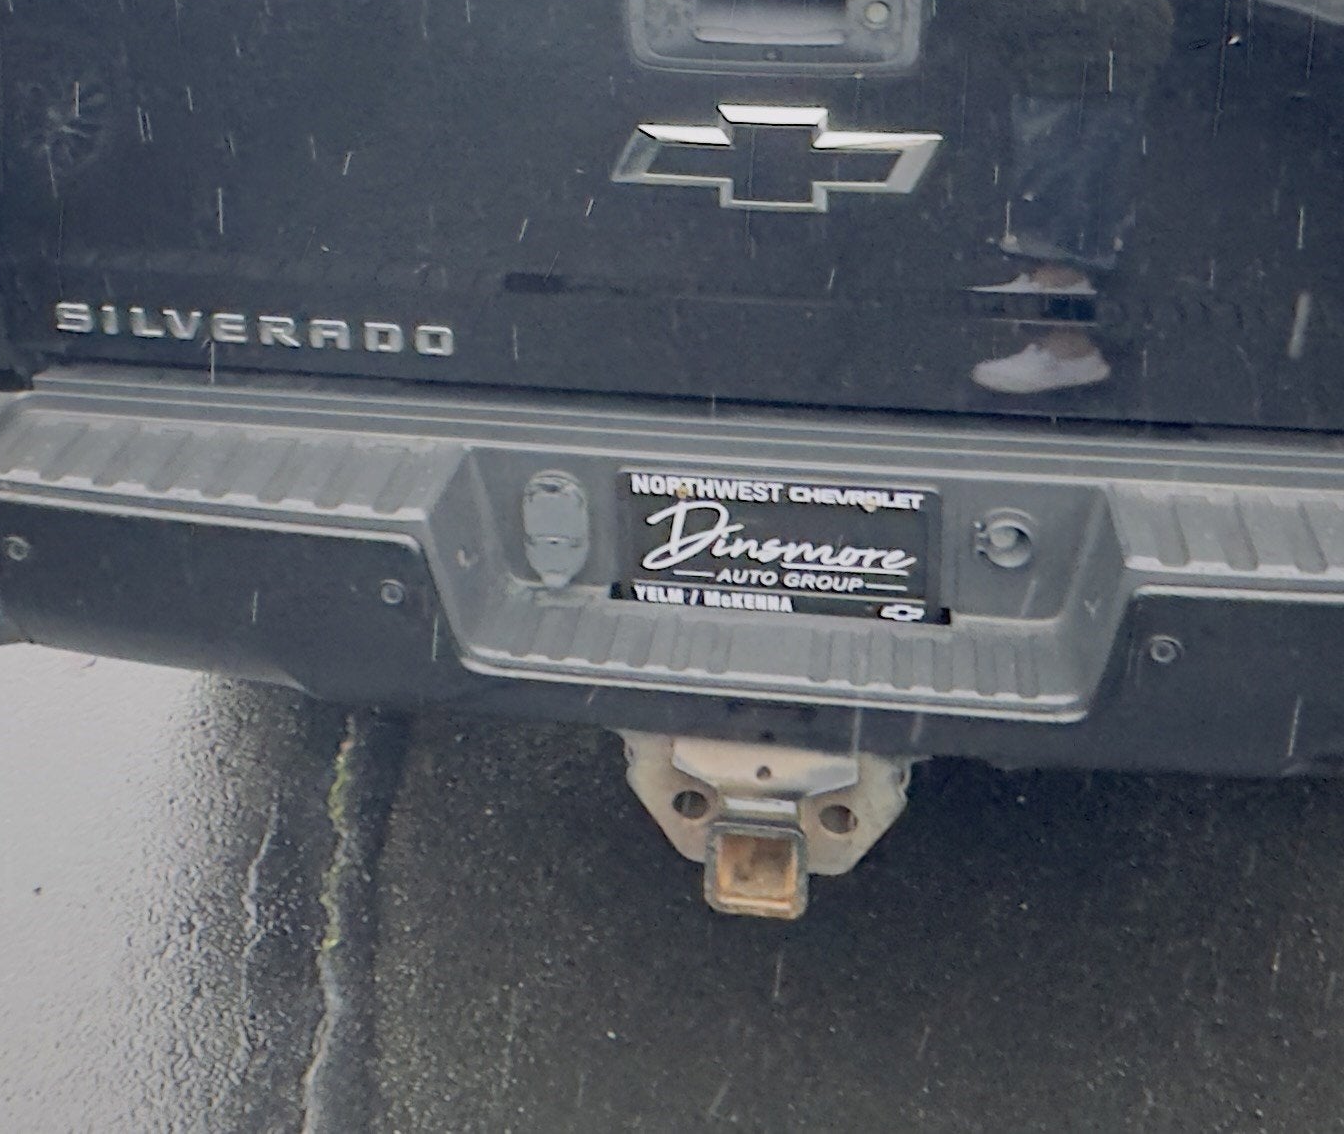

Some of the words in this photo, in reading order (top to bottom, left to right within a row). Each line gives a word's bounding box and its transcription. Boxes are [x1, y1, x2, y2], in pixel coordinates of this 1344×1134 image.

[56, 302, 454, 356] SILVERADO
[630, 473, 783, 503] NORTHWEST
[788, 485, 924, 510] CHEVROLET
[642, 500, 918, 571] Dinsmore
[634, 583, 684, 604] YELM
[716, 568, 778, 587] AUTO
[783, 572, 865, 592] GROUP
